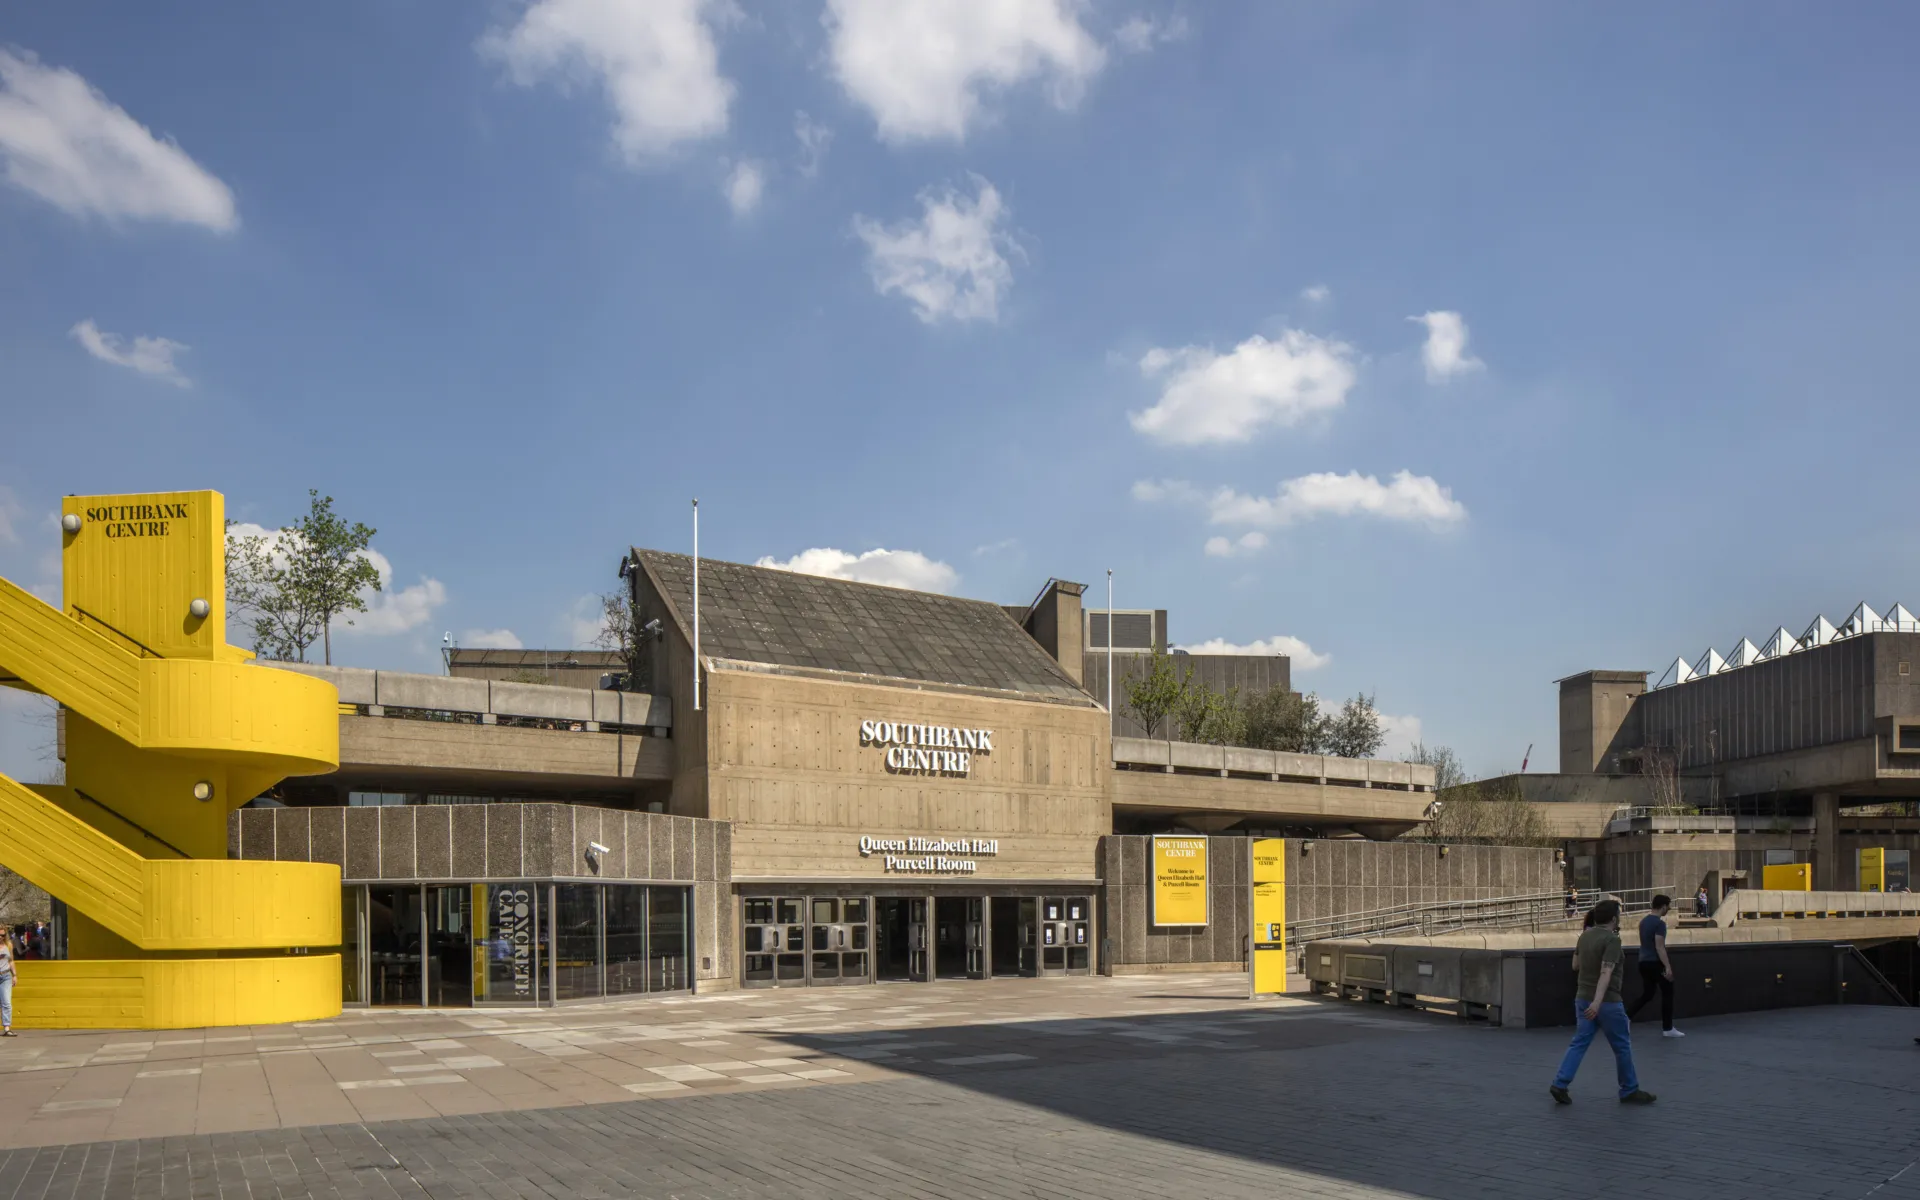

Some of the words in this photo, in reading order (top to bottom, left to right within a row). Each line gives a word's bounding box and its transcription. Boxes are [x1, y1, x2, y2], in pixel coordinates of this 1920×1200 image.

[86, 503, 188, 523] SOUTHBANK
[105, 521, 169, 538] CENTRE
[861, 720, 994, 750] SOUTHBANK
[887, 748, 971, 772] CENTRE
[859, 836, 906, 853] Queen
[908, 837, 970, 852] Elizabeth
[972, 839, 998, 853] Hall
[1157, 840, 1205, 849] SOUTHBANK
[1165, 849, 1197, 857] CENTRE
[886, 856, 934, 870] Purcell
[936, 857, 976, 871] Room
[499, 889, 514, 940] CAFE
[514, 889, 529, 995] CONCRETE
